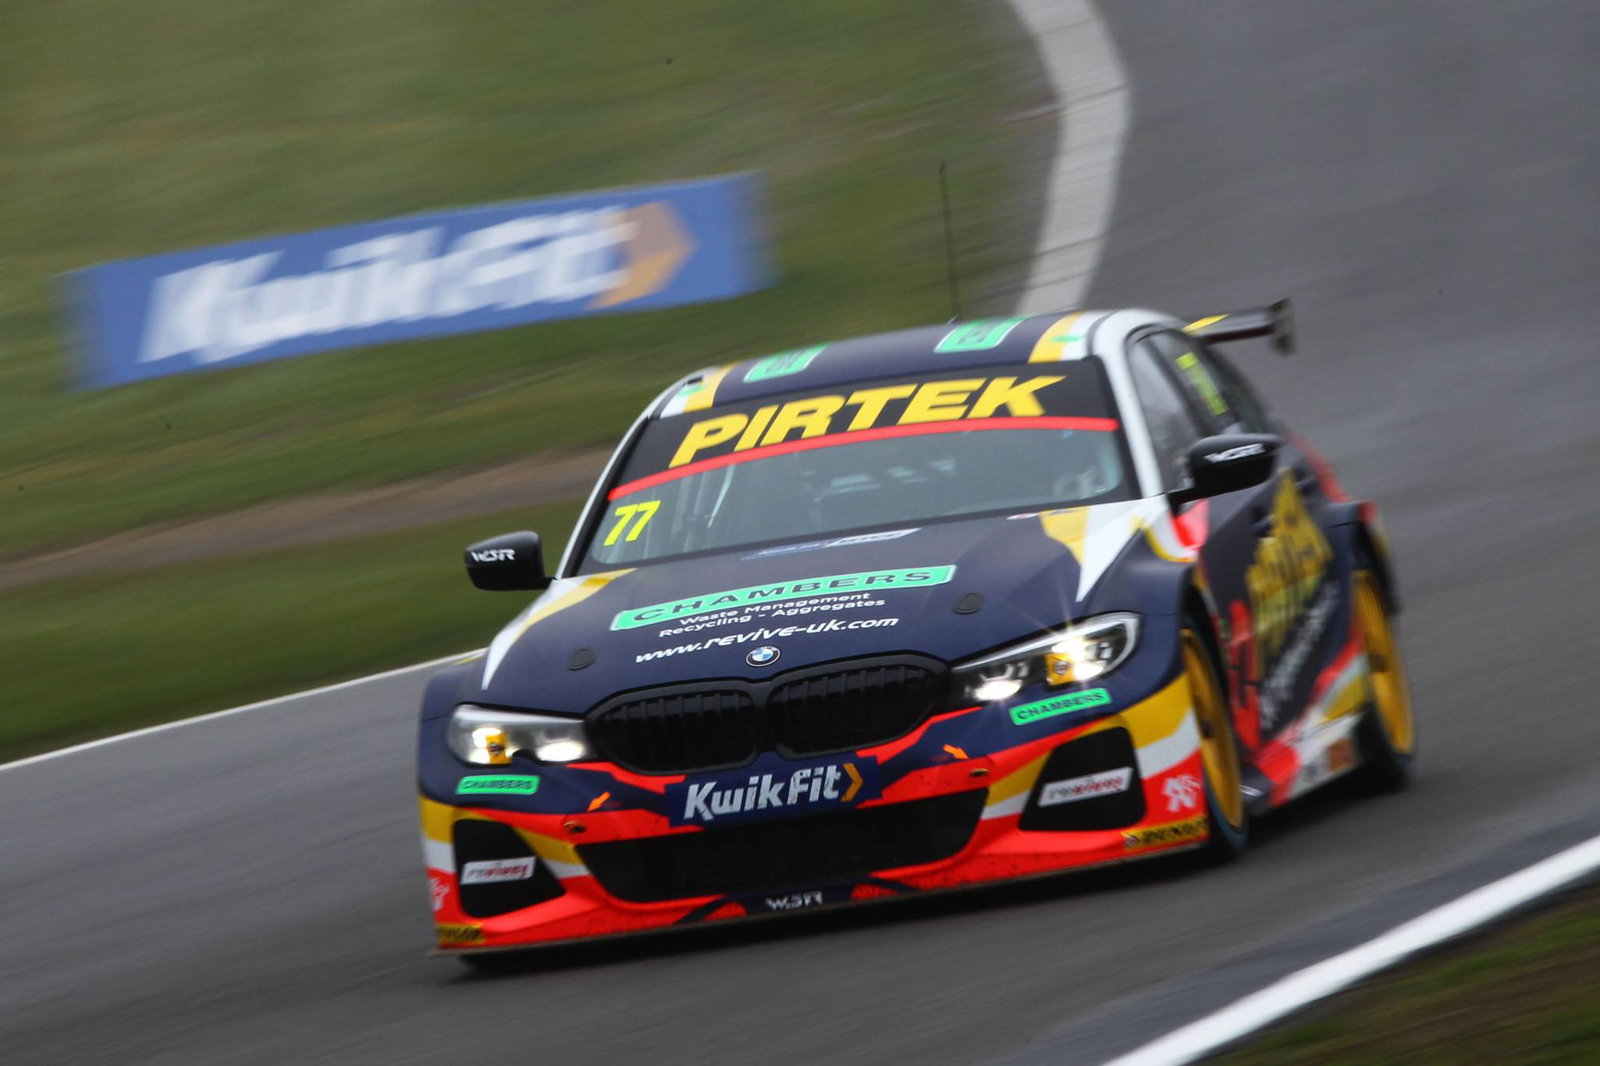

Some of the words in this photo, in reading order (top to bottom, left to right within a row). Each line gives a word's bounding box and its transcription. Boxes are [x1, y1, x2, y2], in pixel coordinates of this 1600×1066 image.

[668, 375, 1067, 468] PIRTEK
[604, 501, 661, 546] 77
[634, 571, 933, 622] CHAMBERS
[659, 614, 751, 638] Recycling
[771, 599, 886, 619] Aggregates
[680, 609, 738, 626] Waste
[744, 593, 872, 614] Management
[635, 617, 899, 664] www.revive-uk.com
[1017, 693, 1105, 719] CHAMBERS
